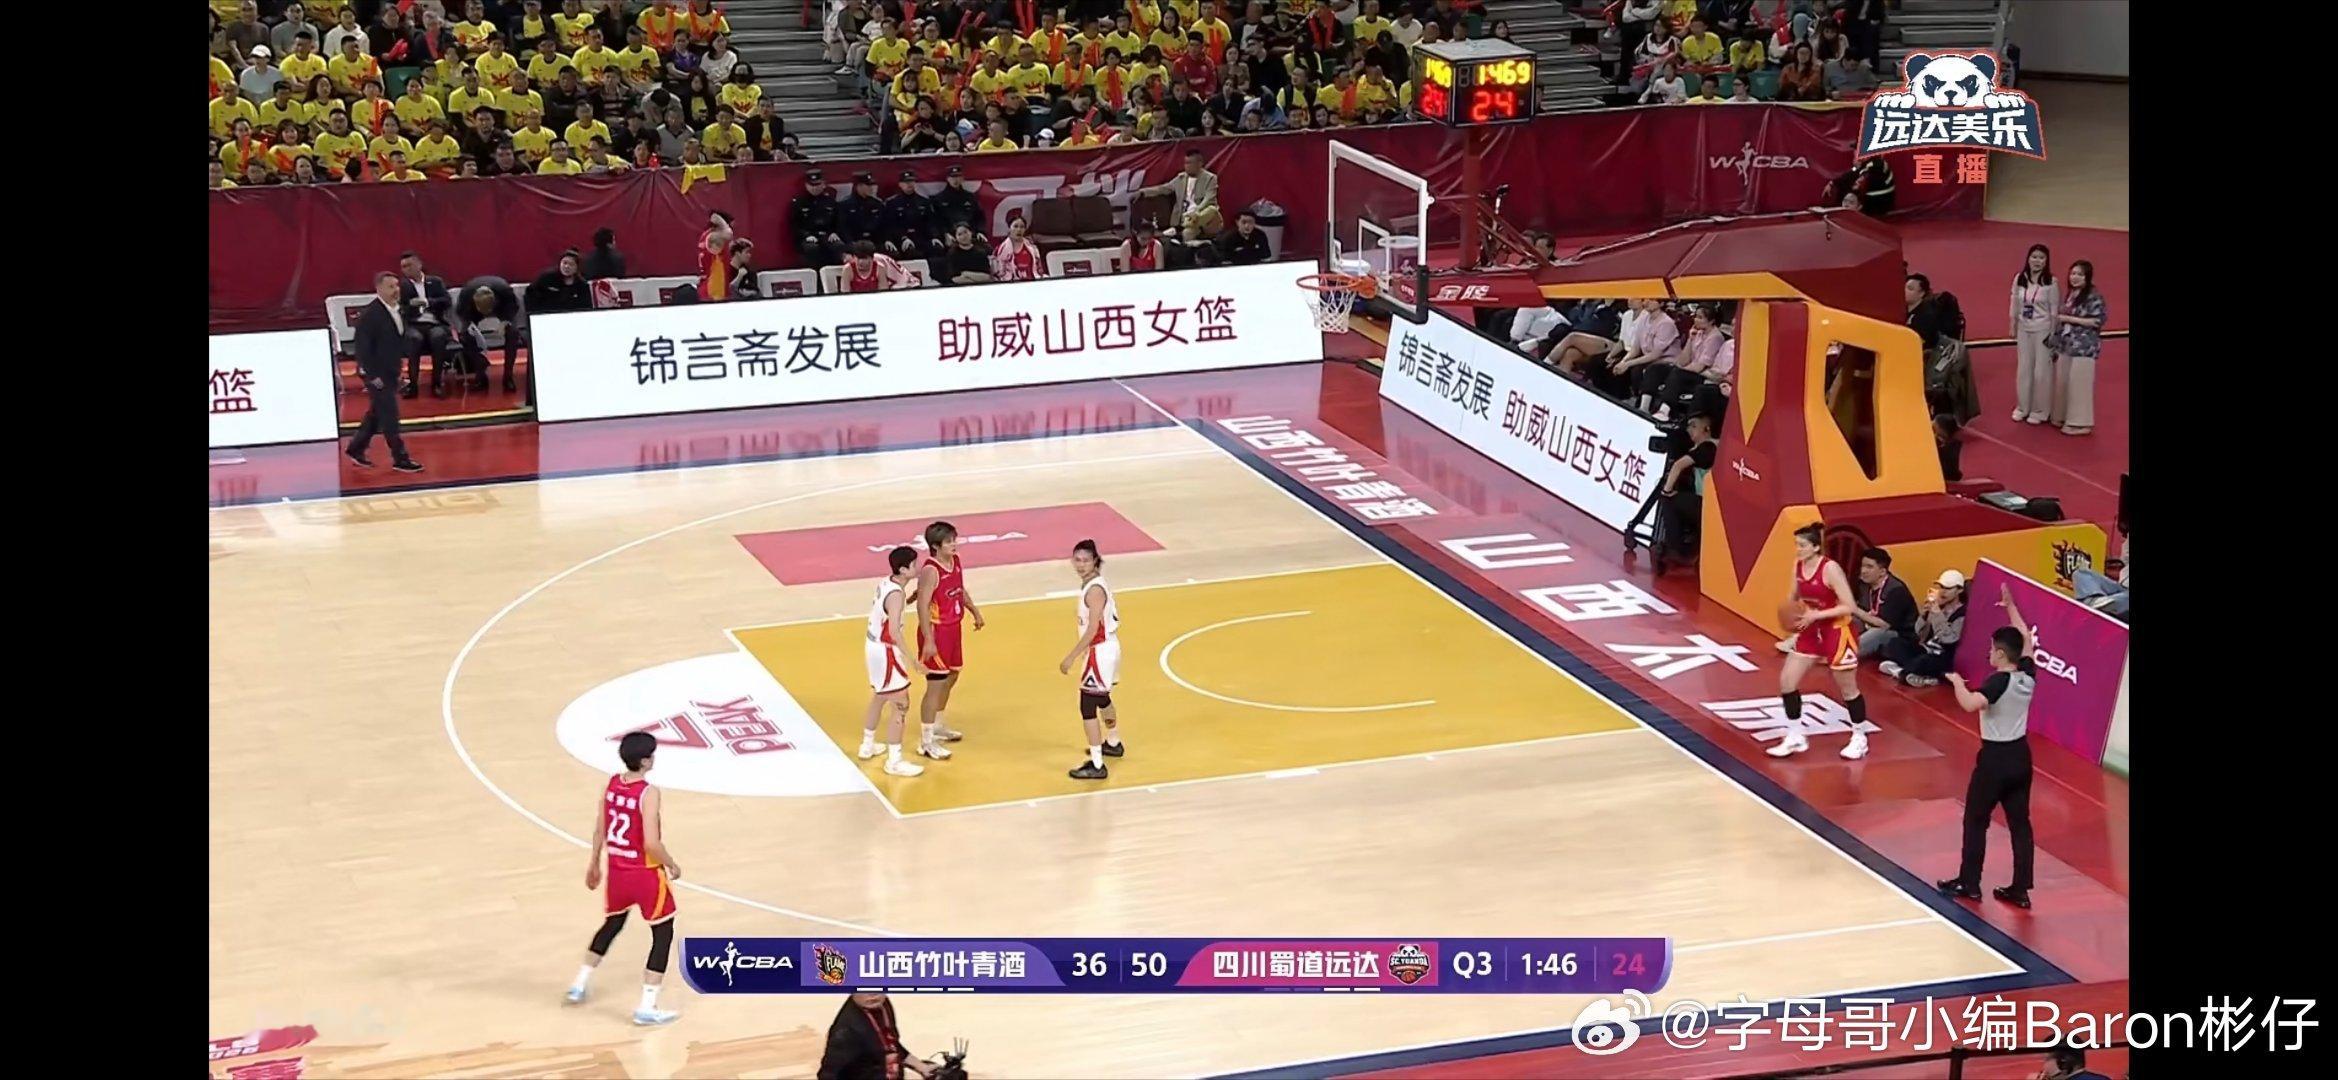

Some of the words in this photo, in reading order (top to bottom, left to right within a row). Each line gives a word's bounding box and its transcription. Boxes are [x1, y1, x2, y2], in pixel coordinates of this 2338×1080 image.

[1472, 91, 1515, 121] 24
[629, 323, 882, 386] 锦言斋发展
[937, 296, 1239, 363] 助威山西女篮
[209, 367, 258, 414] 篮
[1398, 330, 1495, 421] 锦言斋发展
[1502, 389, 1648, 504] 助威山西女篮
[1216, 415, 1439, 520] 山西竹叶青酒
[690, 695, 798, 756] PEAK
[607, 808, 631, 846] 22
